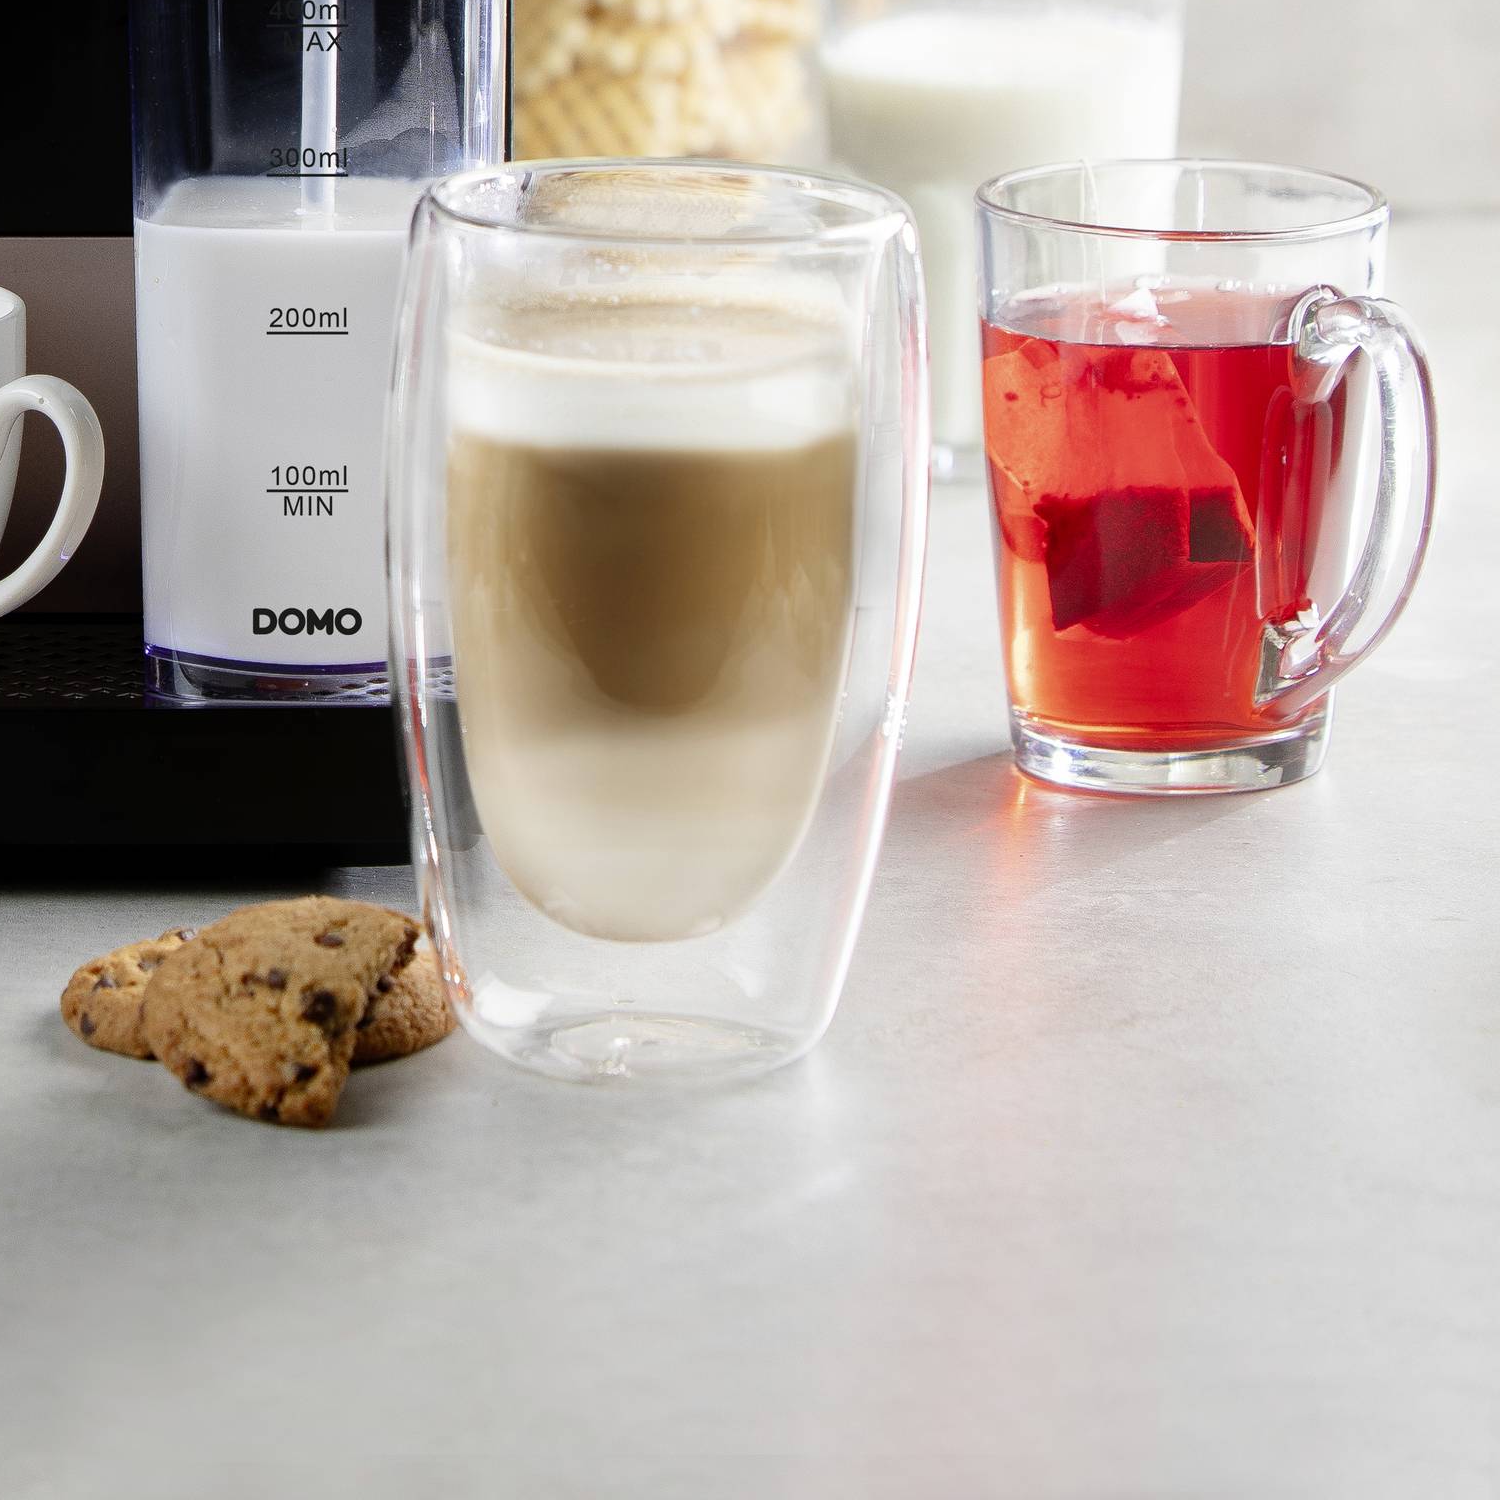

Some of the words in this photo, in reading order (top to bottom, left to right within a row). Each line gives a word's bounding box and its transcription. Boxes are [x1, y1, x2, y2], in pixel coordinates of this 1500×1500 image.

[269, 148, 348, 169] 300ml
[269, 307, 348, 328] 200ml
[271, 465, 348, 486] 100ml
[283, 495, 334, 517] MIN
[252, 607, 363, 636] DOMO
